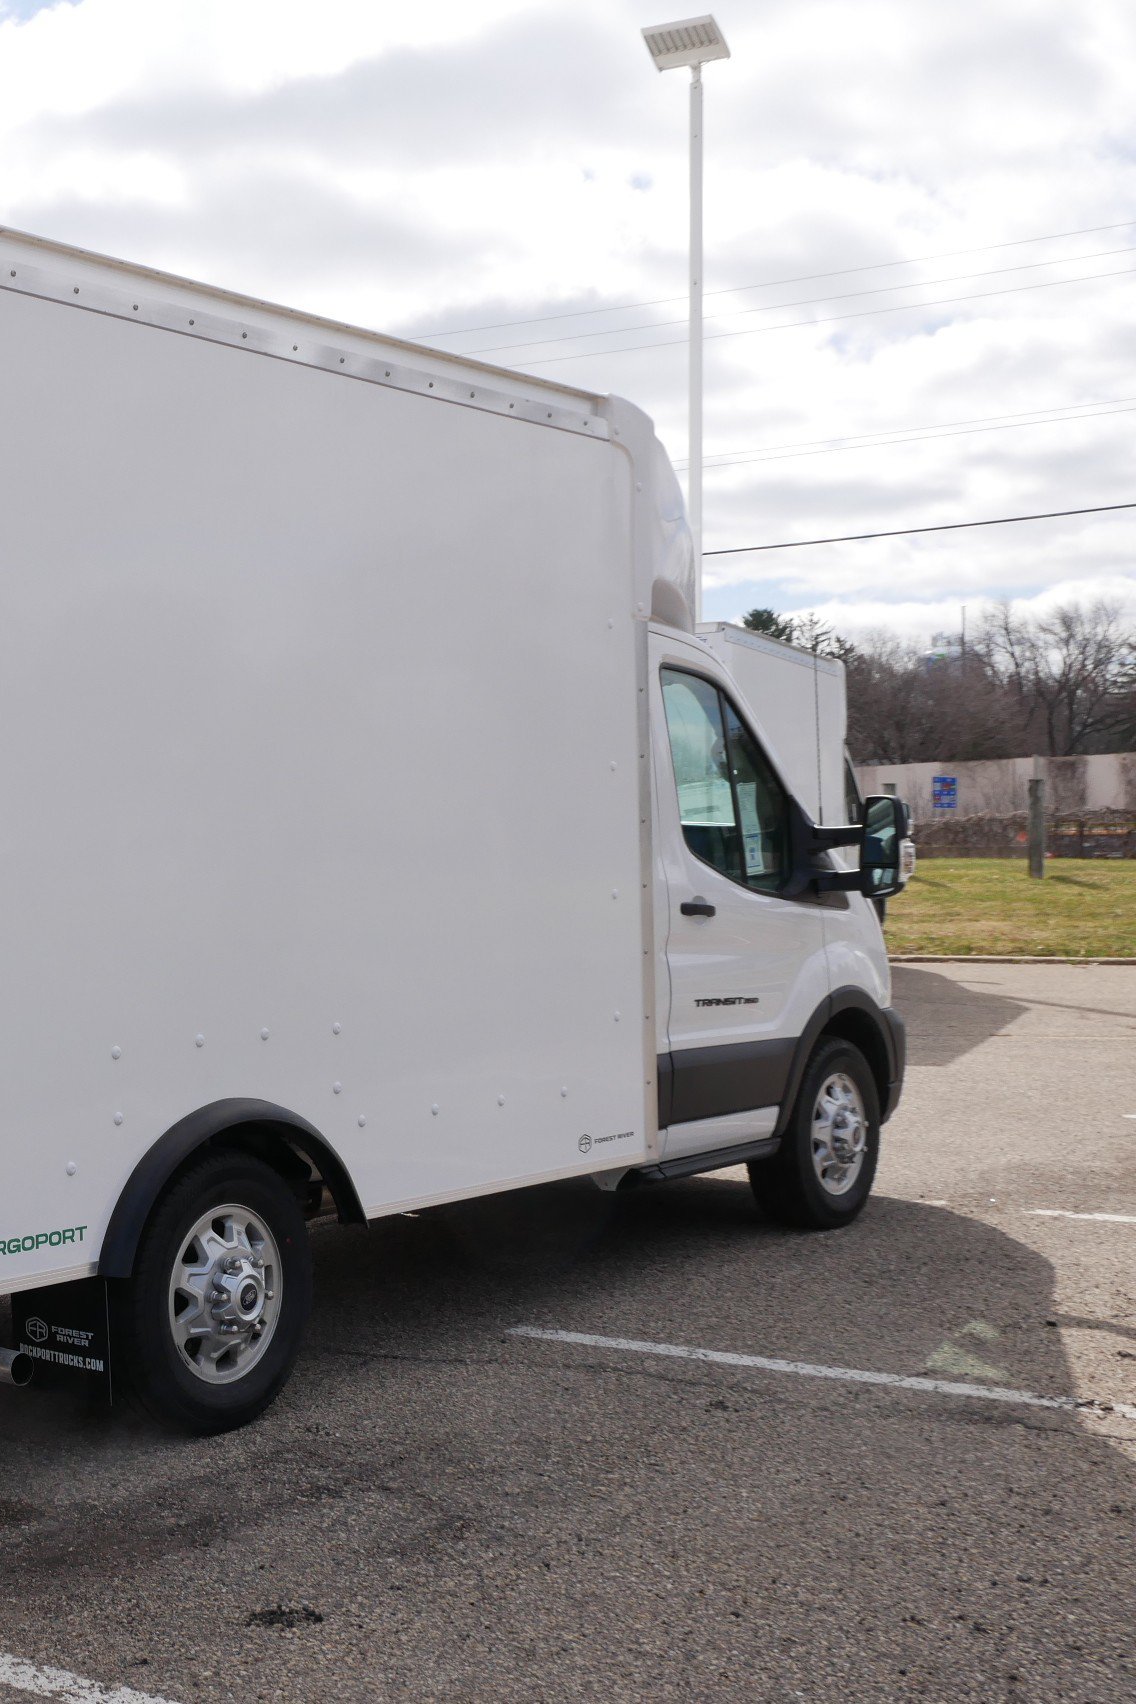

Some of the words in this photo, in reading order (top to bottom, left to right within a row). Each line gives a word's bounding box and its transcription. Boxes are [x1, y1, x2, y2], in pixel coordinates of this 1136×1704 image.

[694, 997, 743, 1007] TRANSIT
[594, 1134, 616, 1144] FOREST
[51, 1325, 94, 1340] FOREST
[56, 1334, 89, 1347] RIVER
[20, 1342, 104, 1372] ROCKPORTTRUCKS.COM
